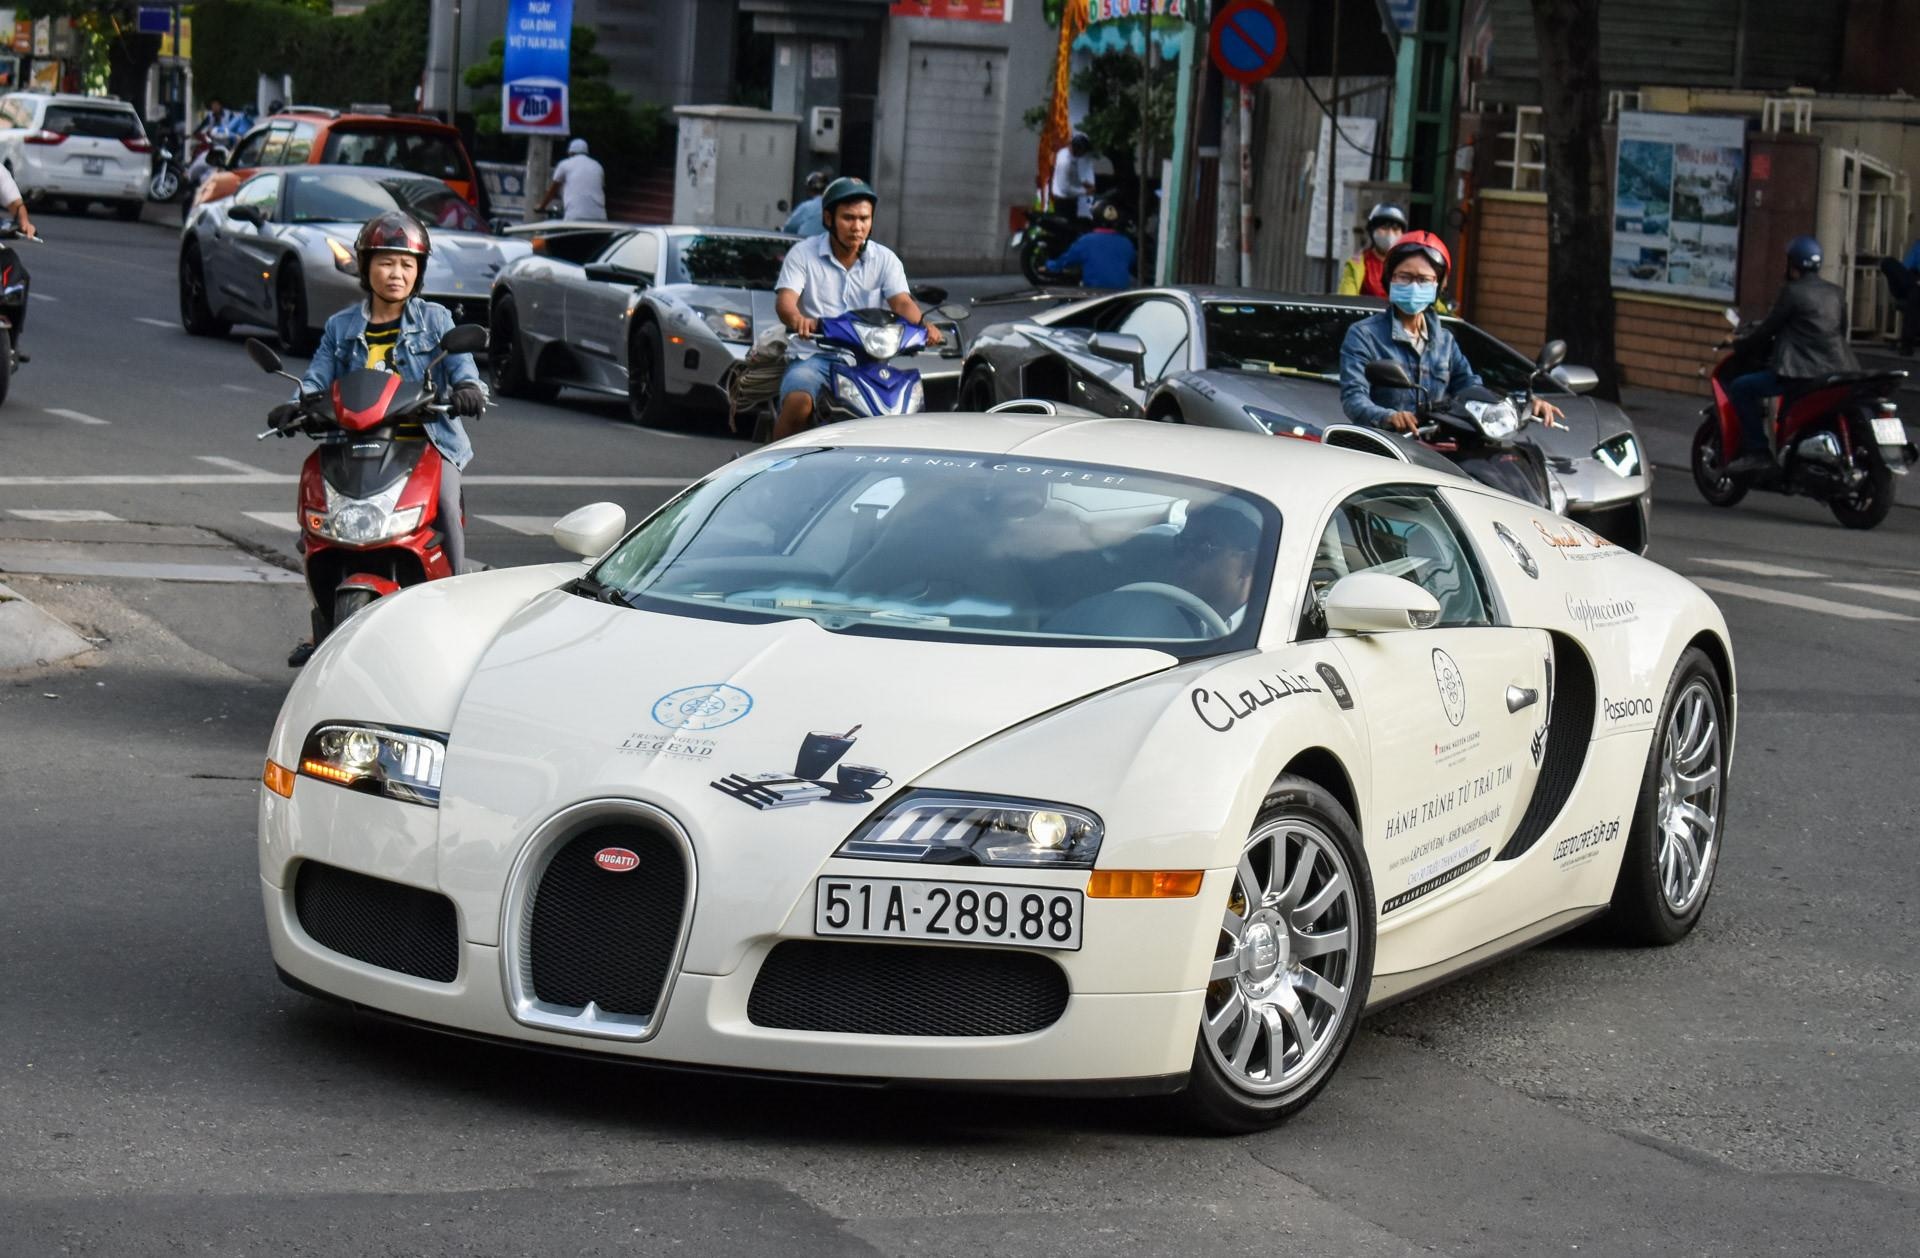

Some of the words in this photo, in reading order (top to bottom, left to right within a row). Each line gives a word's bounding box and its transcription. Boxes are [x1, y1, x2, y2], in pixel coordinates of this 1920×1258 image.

[520, 19, 535, 31] GIA
[527, 37, 547, 49] NAM
[522, 97, 549, 117] Aba
[854, 455, 913, 465] THE
[1565, 592, 1635, 632] Cappuccino
[1191, 669, 1322, 732] Classic
[1603, 697, 1653, 724] Passiona
[622, 739, 713, 756] LEGEND
[1385, 808, 1418, 839] HÀNH
[1422, 791, 1454, 823] TRÌNH
[1497, 762, 1513, 787] TIM
[599, 853, 635, 866] BUGATTI
[826, 883, 1074, 942] 51A-289.88
